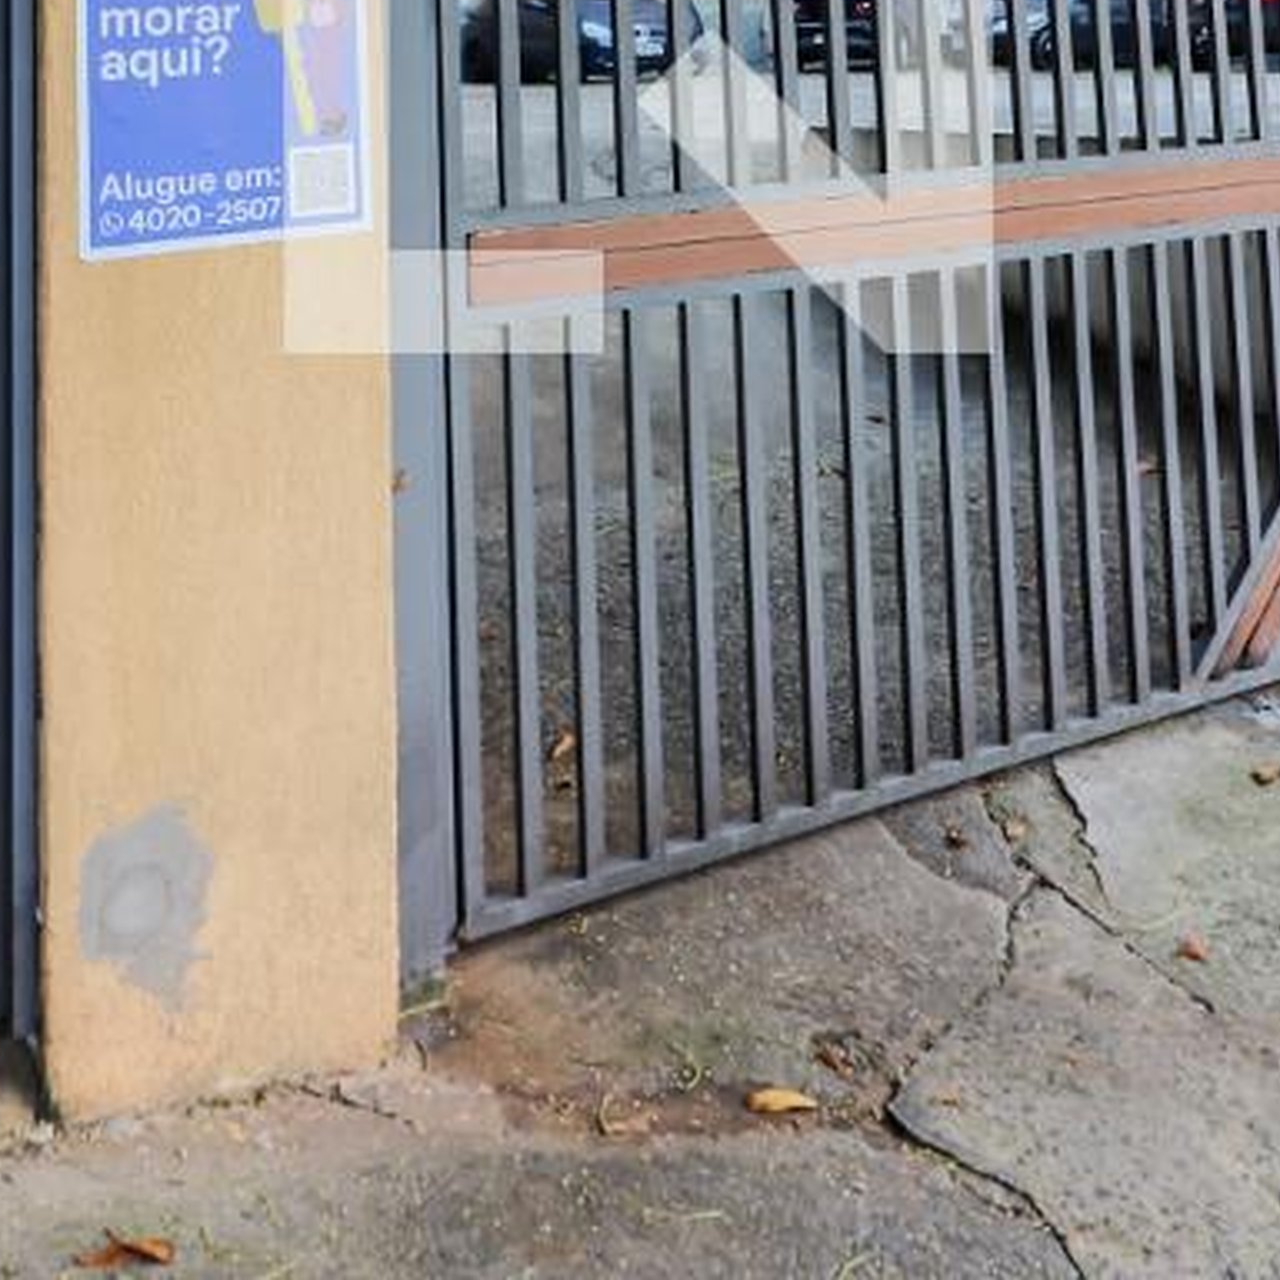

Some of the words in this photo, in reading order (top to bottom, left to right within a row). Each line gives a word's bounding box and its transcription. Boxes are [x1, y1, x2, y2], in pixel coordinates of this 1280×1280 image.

[100, 5, 241, 39] morar
[100, 38, 230, 88] aqui?
[100, 170, 217, 205] Alugue
[225, 164, 282, 192] em:
